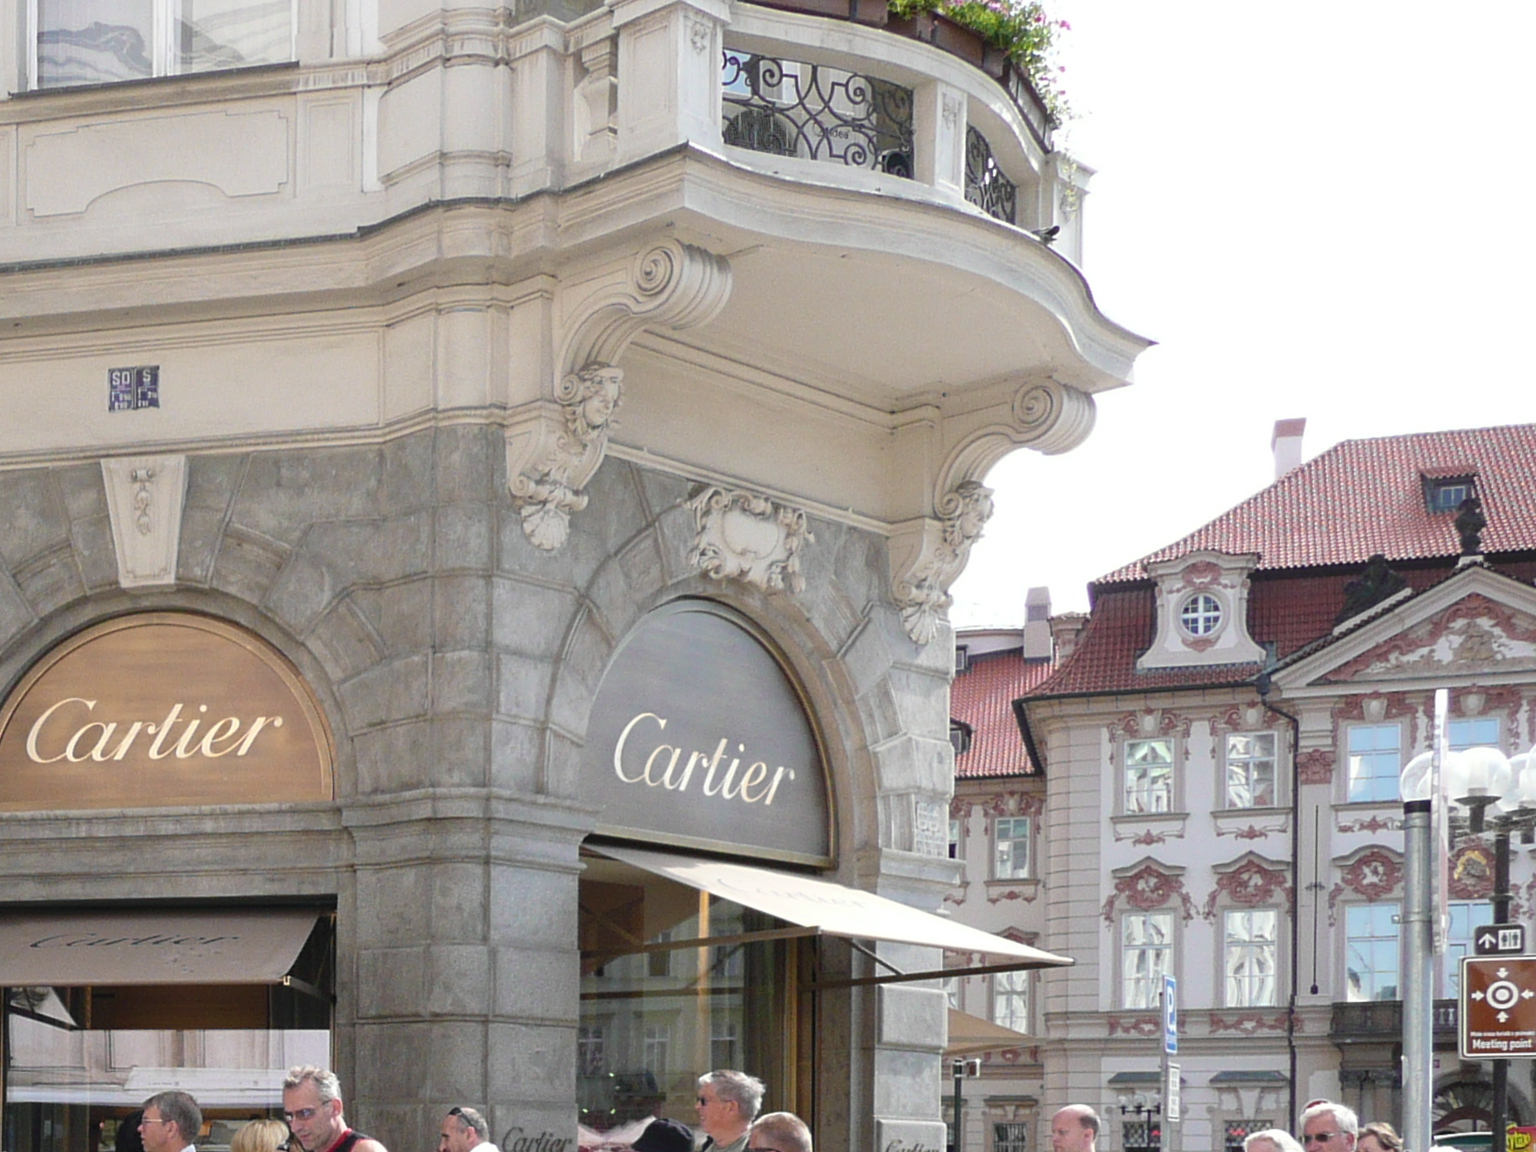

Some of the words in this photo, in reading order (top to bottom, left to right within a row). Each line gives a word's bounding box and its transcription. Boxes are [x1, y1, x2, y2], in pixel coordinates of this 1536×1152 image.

[26, 697, 283, 764] Cartier
[614, 712, 796, 806] Cartier
[29, 932, 240, 948] Cartier
[1167, 984, 1175, 1028] P
[1472, 1038, 1508, 1051] Meeting
[1509, 1038, 1532, 1051] point
